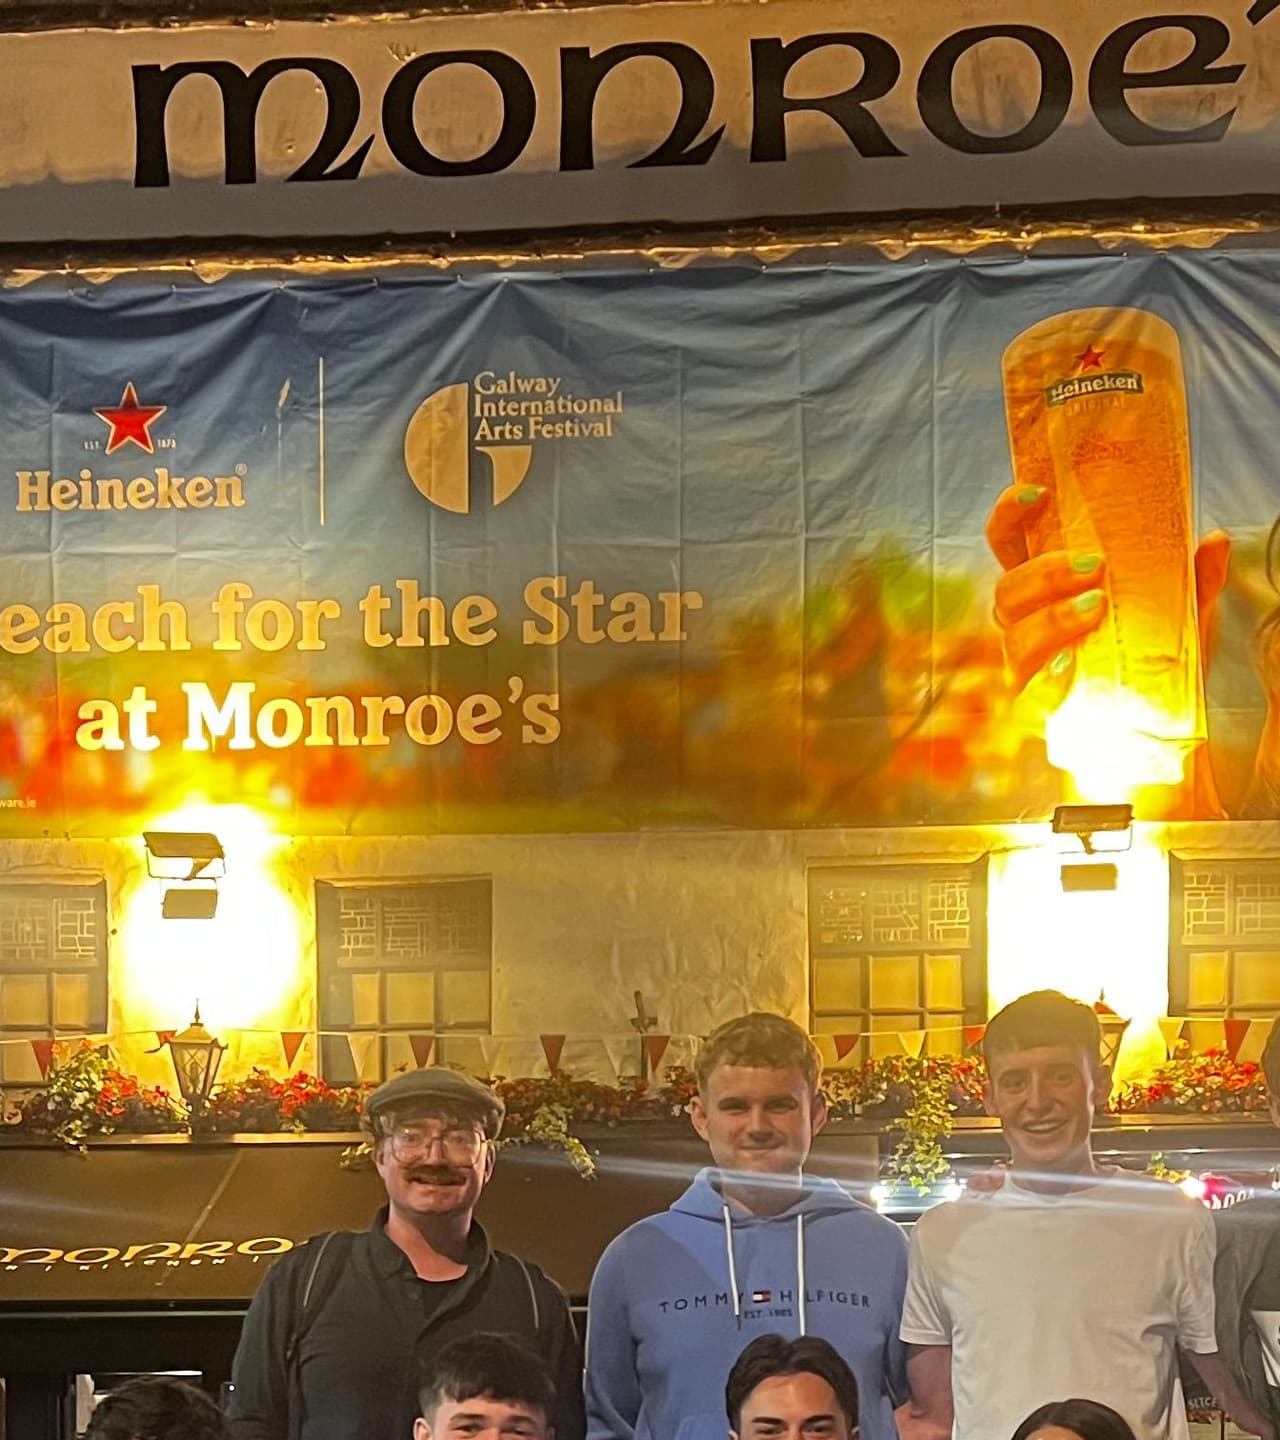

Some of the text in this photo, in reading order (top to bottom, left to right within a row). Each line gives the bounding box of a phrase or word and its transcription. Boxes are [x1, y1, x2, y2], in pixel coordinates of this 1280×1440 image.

[474, 371, 561, 396] Galway
[1050, 374, 1139, 402] Heineken
[474, 391, 624, 417] International
[474, 415, 613, 441] Arts Festival
[15, 467, 246, 511] Heineken
[212, 582, 341, 652] for
[361, 578, 498, 648] the
[521, 575, 704, 646] Star
[75, 675, 561, 751] at Monroe's
[780, 1290, 870, 1308] HLFIGER
